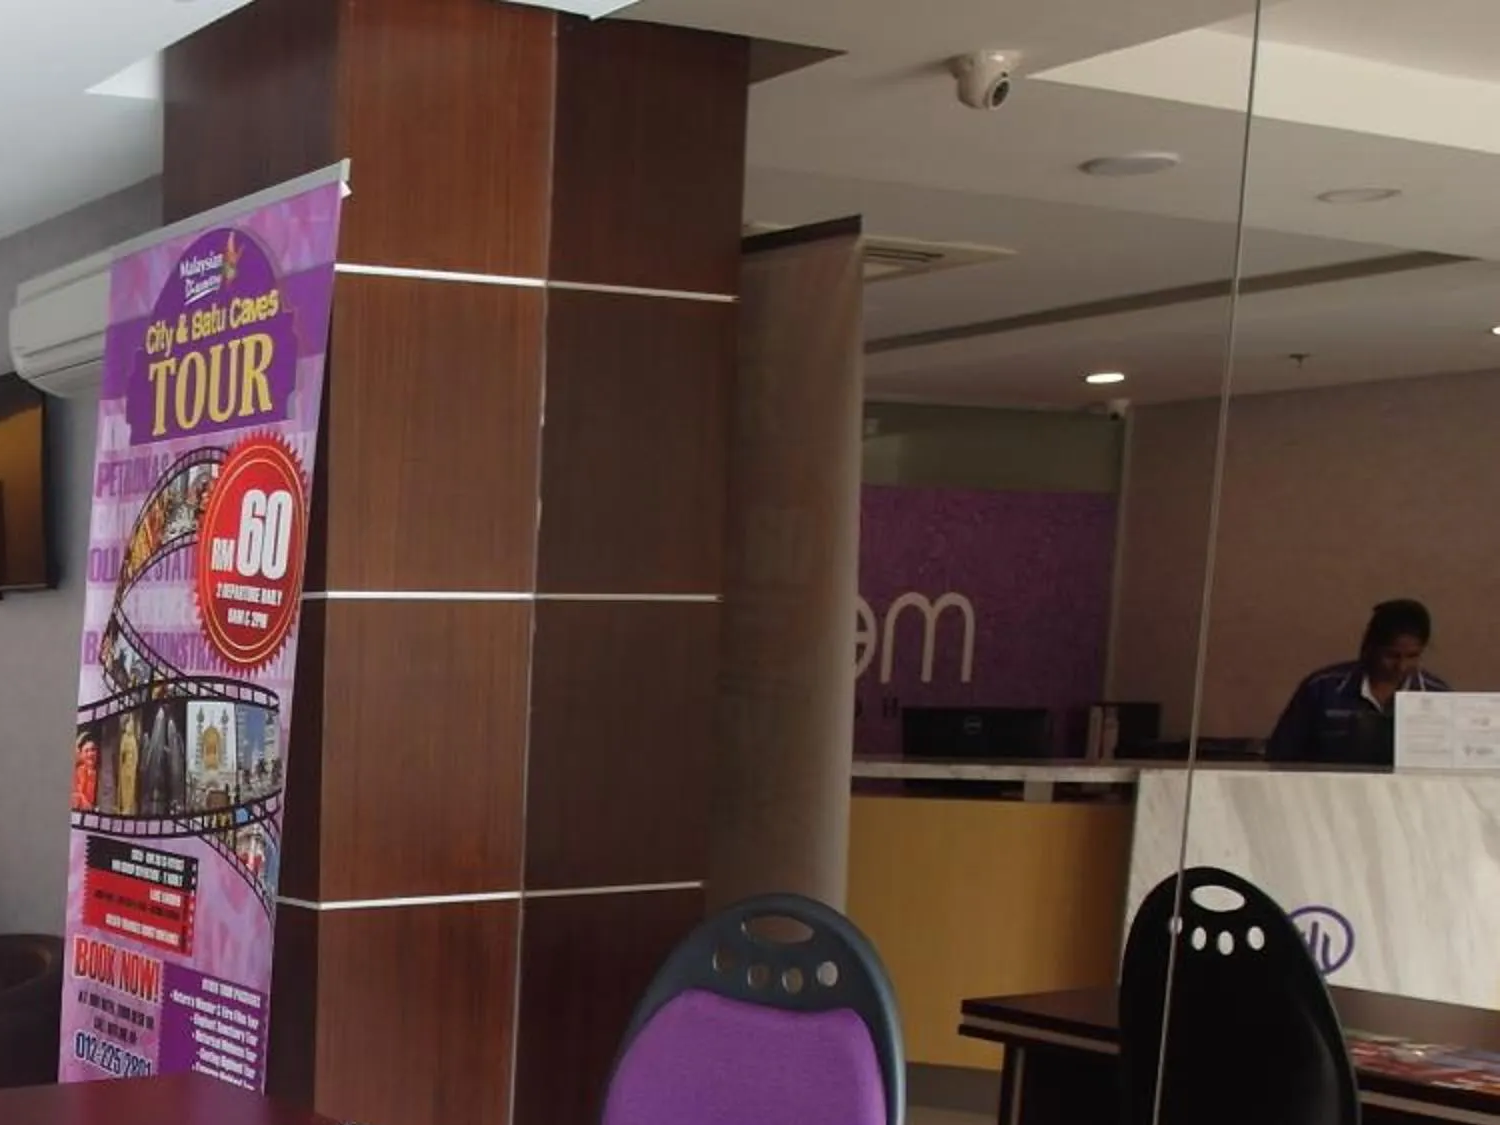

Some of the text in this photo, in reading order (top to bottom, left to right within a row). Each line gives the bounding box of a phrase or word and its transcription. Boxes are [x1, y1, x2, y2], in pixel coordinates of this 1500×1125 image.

[146, 320, 174, 357] City
[191, 303, 226, 341] Batu
[229, 289, 279, 328] Caves
[148, 332, 273, 436] TOUR
[236, 488, 293, 580] 60
[74, 936, 116, 988] BOOK
[117, 949, 160, 1003] NOW!
